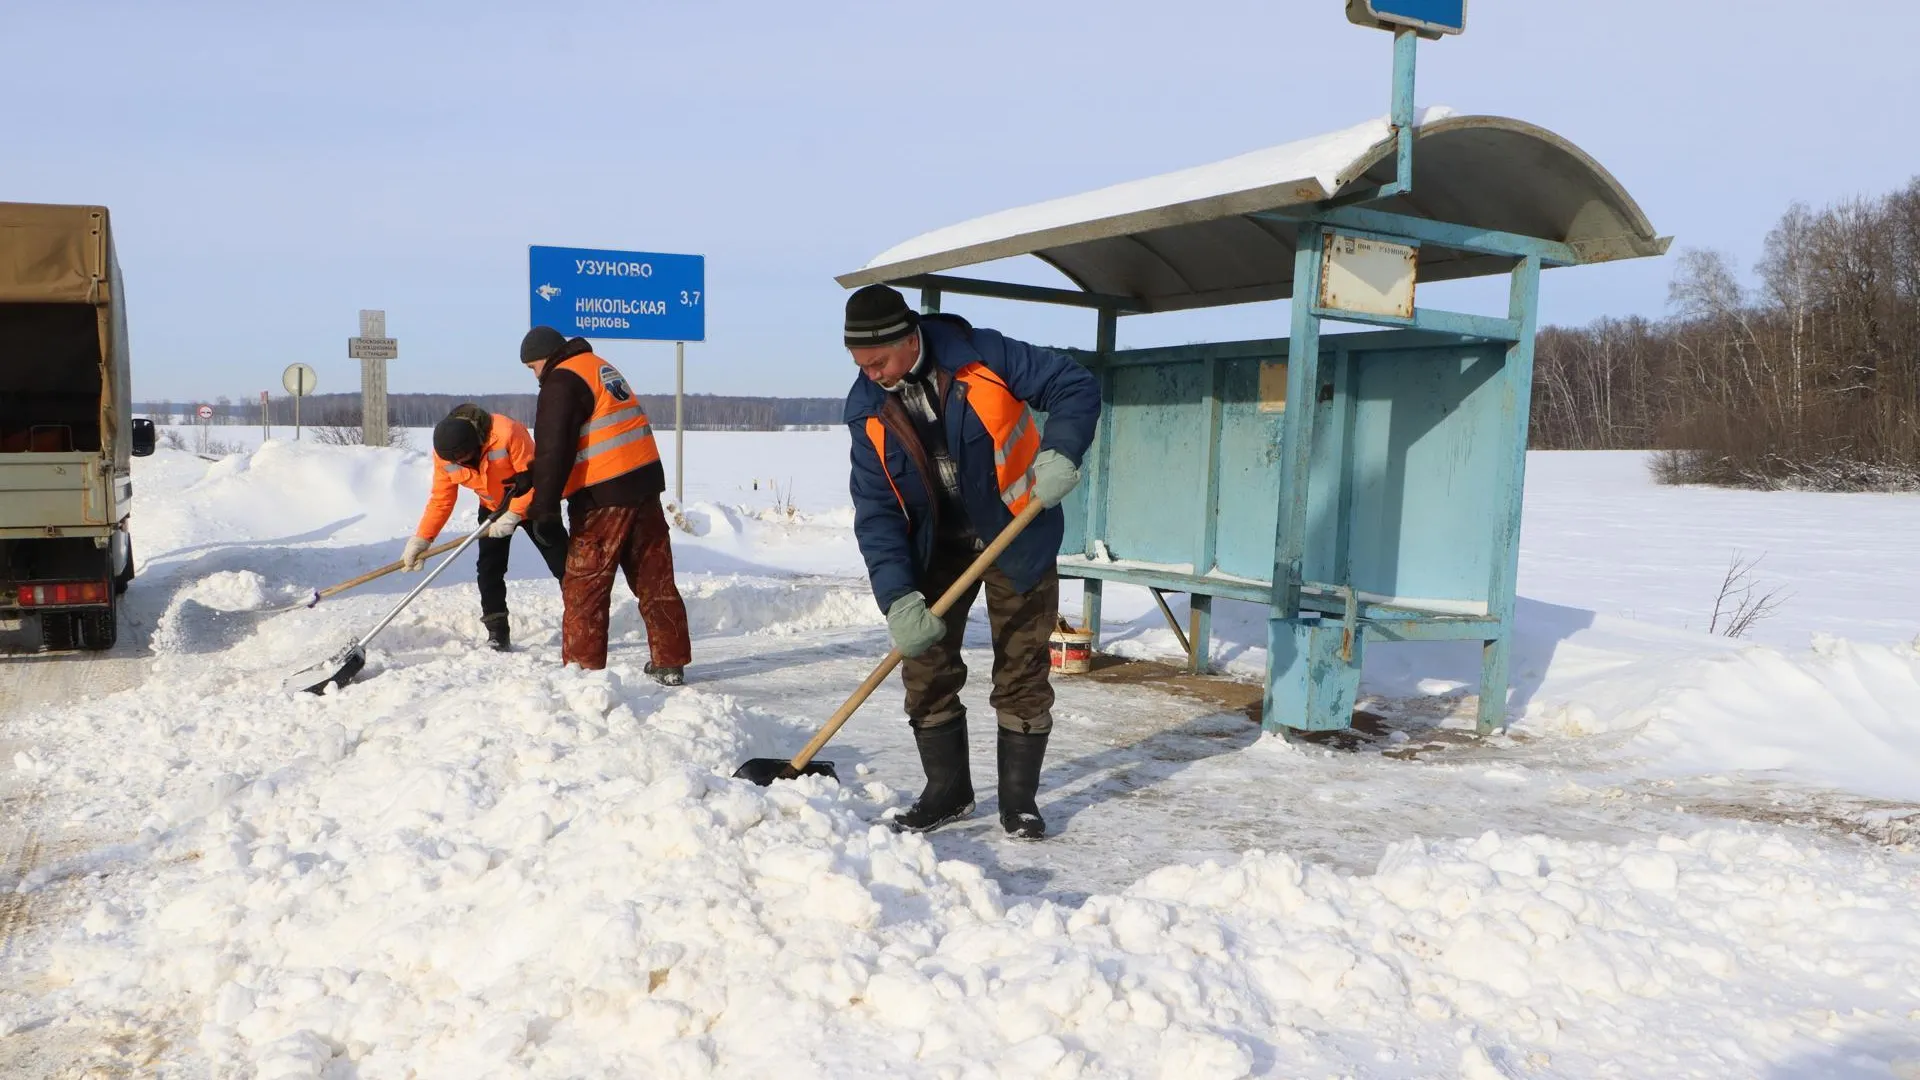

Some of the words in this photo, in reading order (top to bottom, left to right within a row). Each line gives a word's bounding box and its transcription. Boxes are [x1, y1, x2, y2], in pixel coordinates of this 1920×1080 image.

[575, 259, 653, 278] УЗУНОВО
[575, 298, 666, 315] НИКОЛЬСКАЯ
[680, 290, 701, 307] 3,7
[576, 316, 630, 331] церковь
